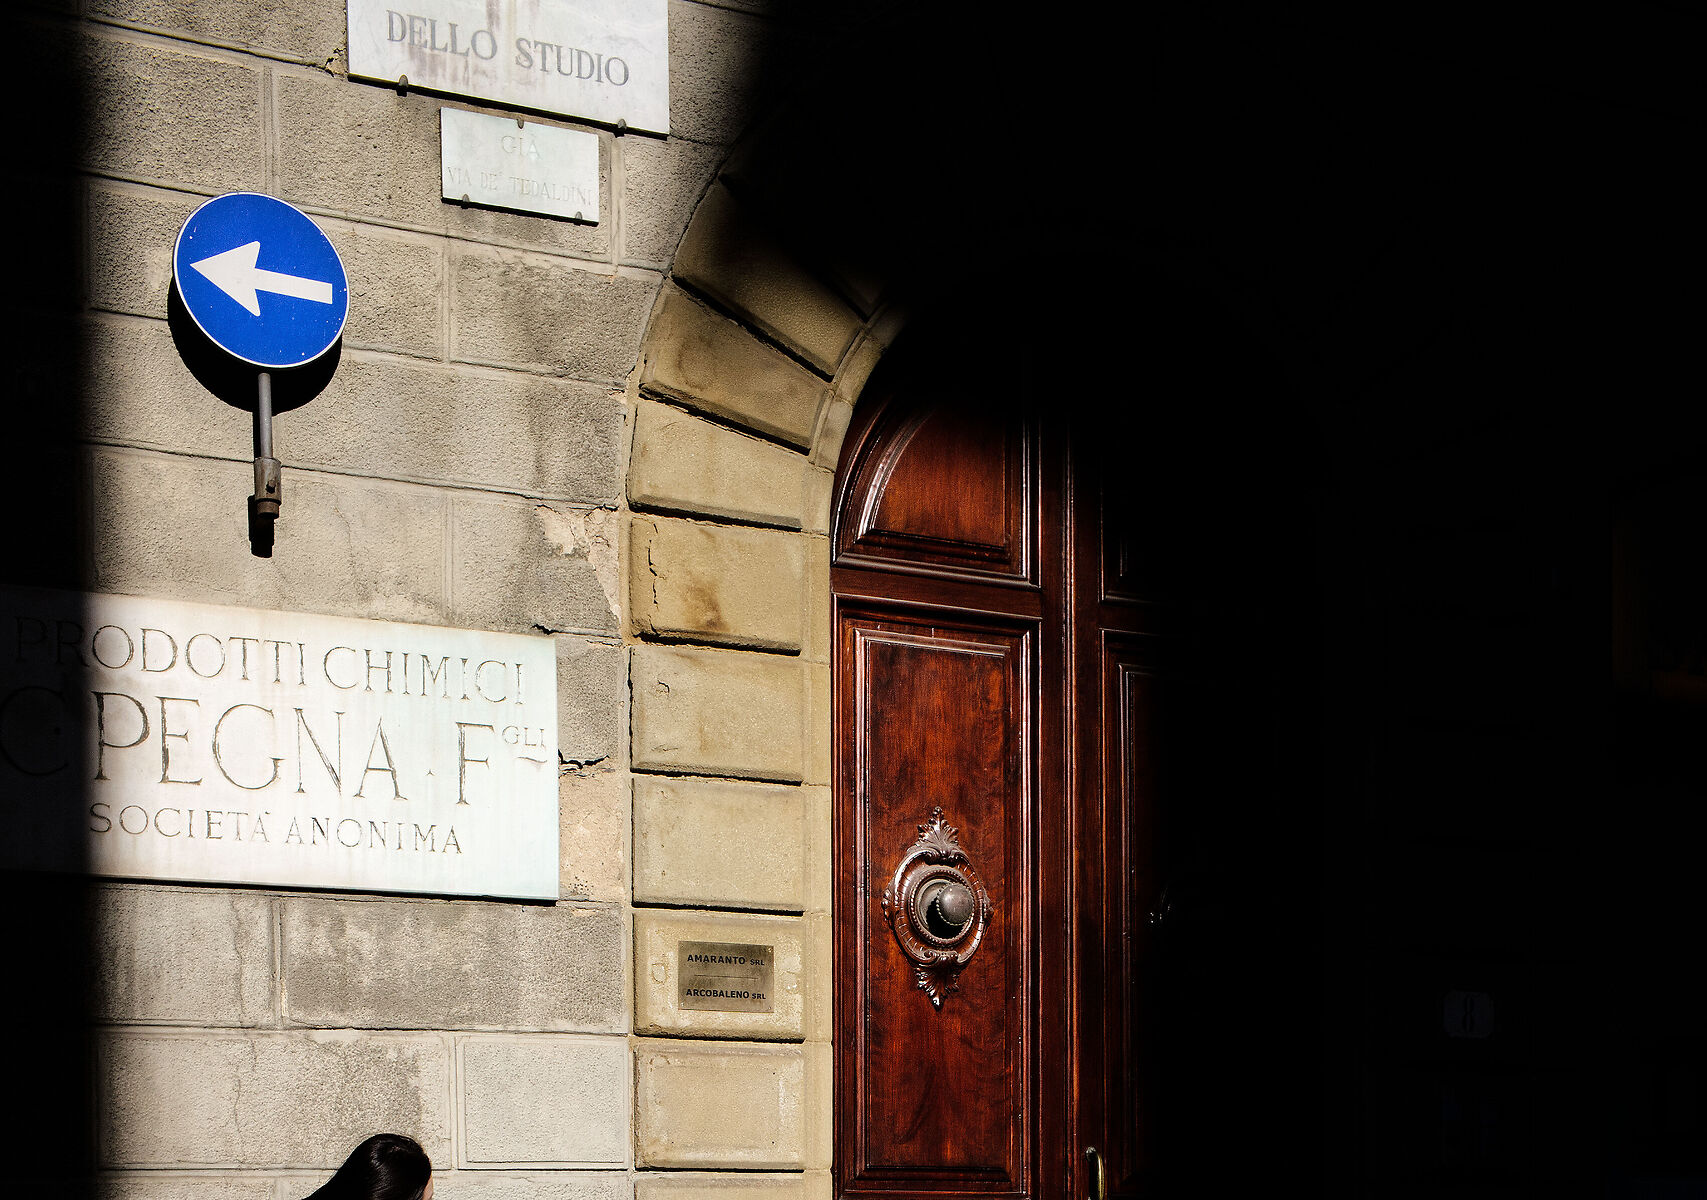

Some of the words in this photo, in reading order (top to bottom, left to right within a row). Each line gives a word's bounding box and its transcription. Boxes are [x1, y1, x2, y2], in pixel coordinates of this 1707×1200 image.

[386, 9, 499, 60] DELLO
[514, 37, 630, 86] STUDIO
[448, 166, 473, 186] VIA
[15, 615, 307, 687] PRODOTTI
[323, 645, 524, 705] CHIMICI
[91, 690, 409, 801] PEGNA
[284, 815, 464, 856] ANONIMA
[687, 954, 746, 965] AMARANTO
[750, 958, 765, 966] SRL
[686, 988, 750, 999] ARCOBALENO
[751, 992, 766, 1000] SRL
